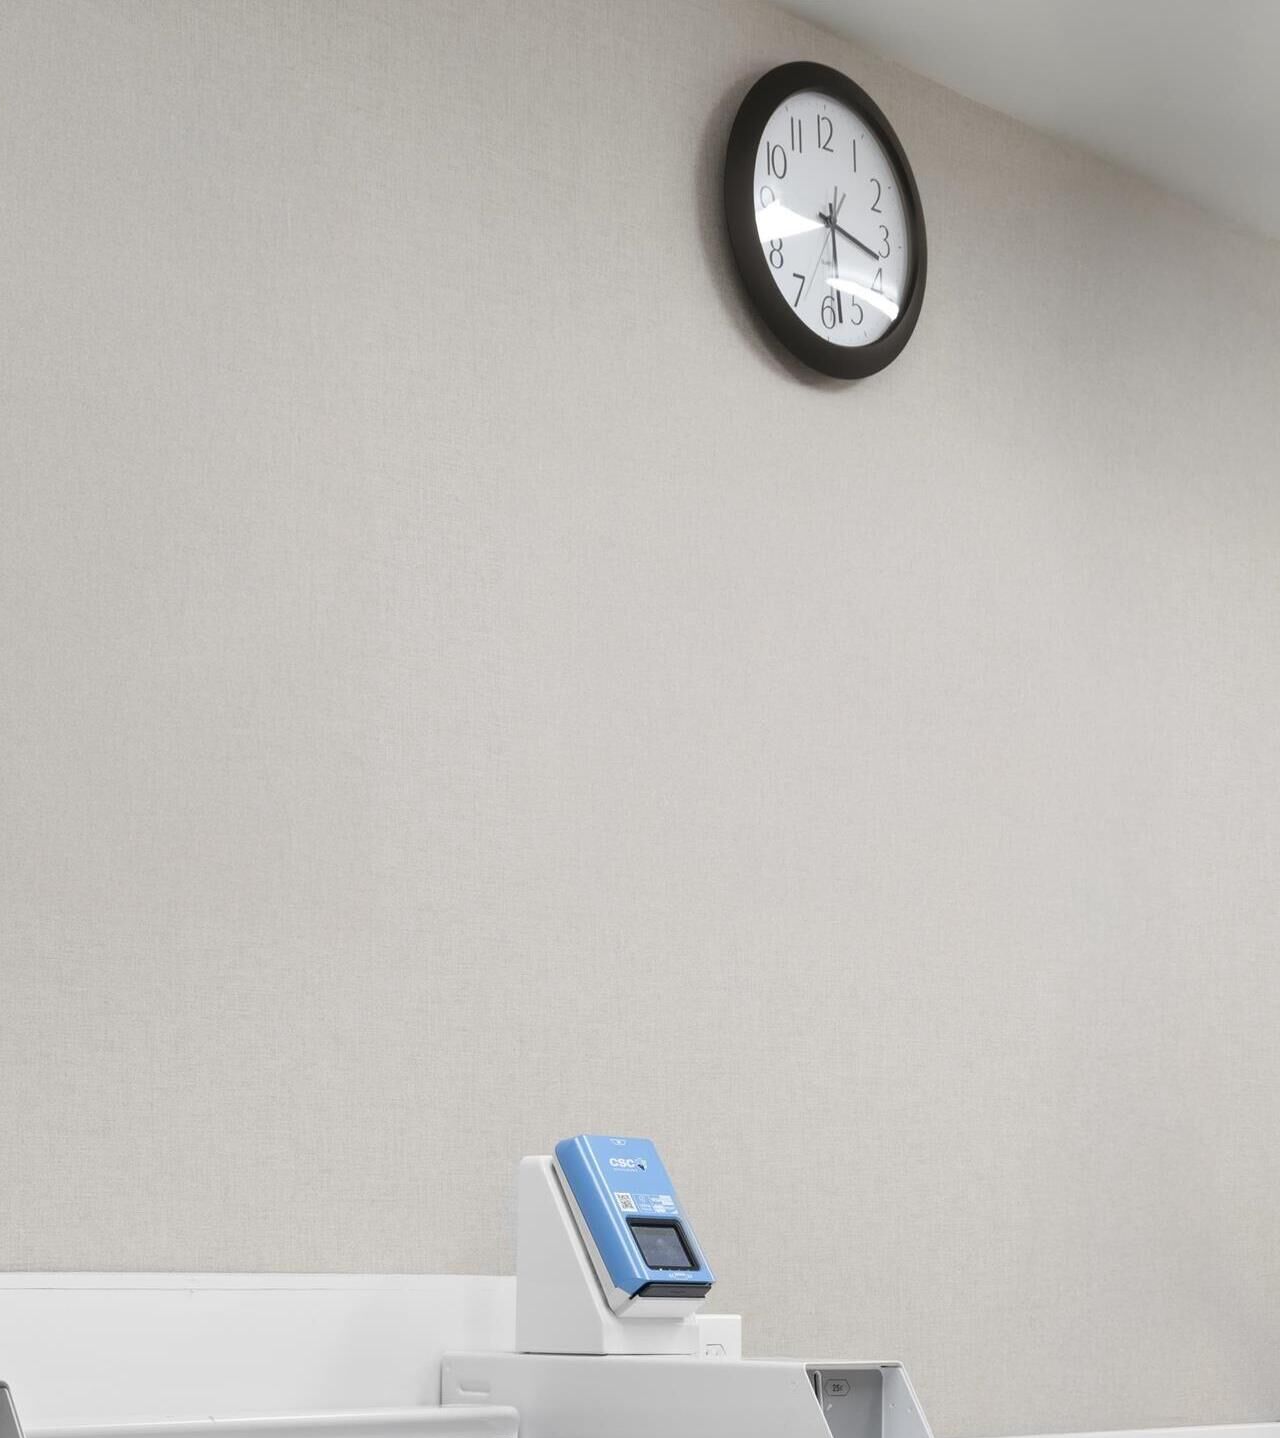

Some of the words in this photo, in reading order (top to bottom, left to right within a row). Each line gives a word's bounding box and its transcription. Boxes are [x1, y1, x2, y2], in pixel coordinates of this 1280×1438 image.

[790, 115, 803, 154] 11
[817, 114, 834, 152] 12
[766, 140, 787, 180] 10
[852, 138, 857, 173] 1
[869, 178, 882, 214] 2
[878, 224, 891, 259] 3
[792, 272, 806, 308] 7
[870, 267, 884, 295] 4
[821, 295, 837, 330] 6
[850, 294, 864, 326] 5
[609, 1158, 635, 1168] CSC
